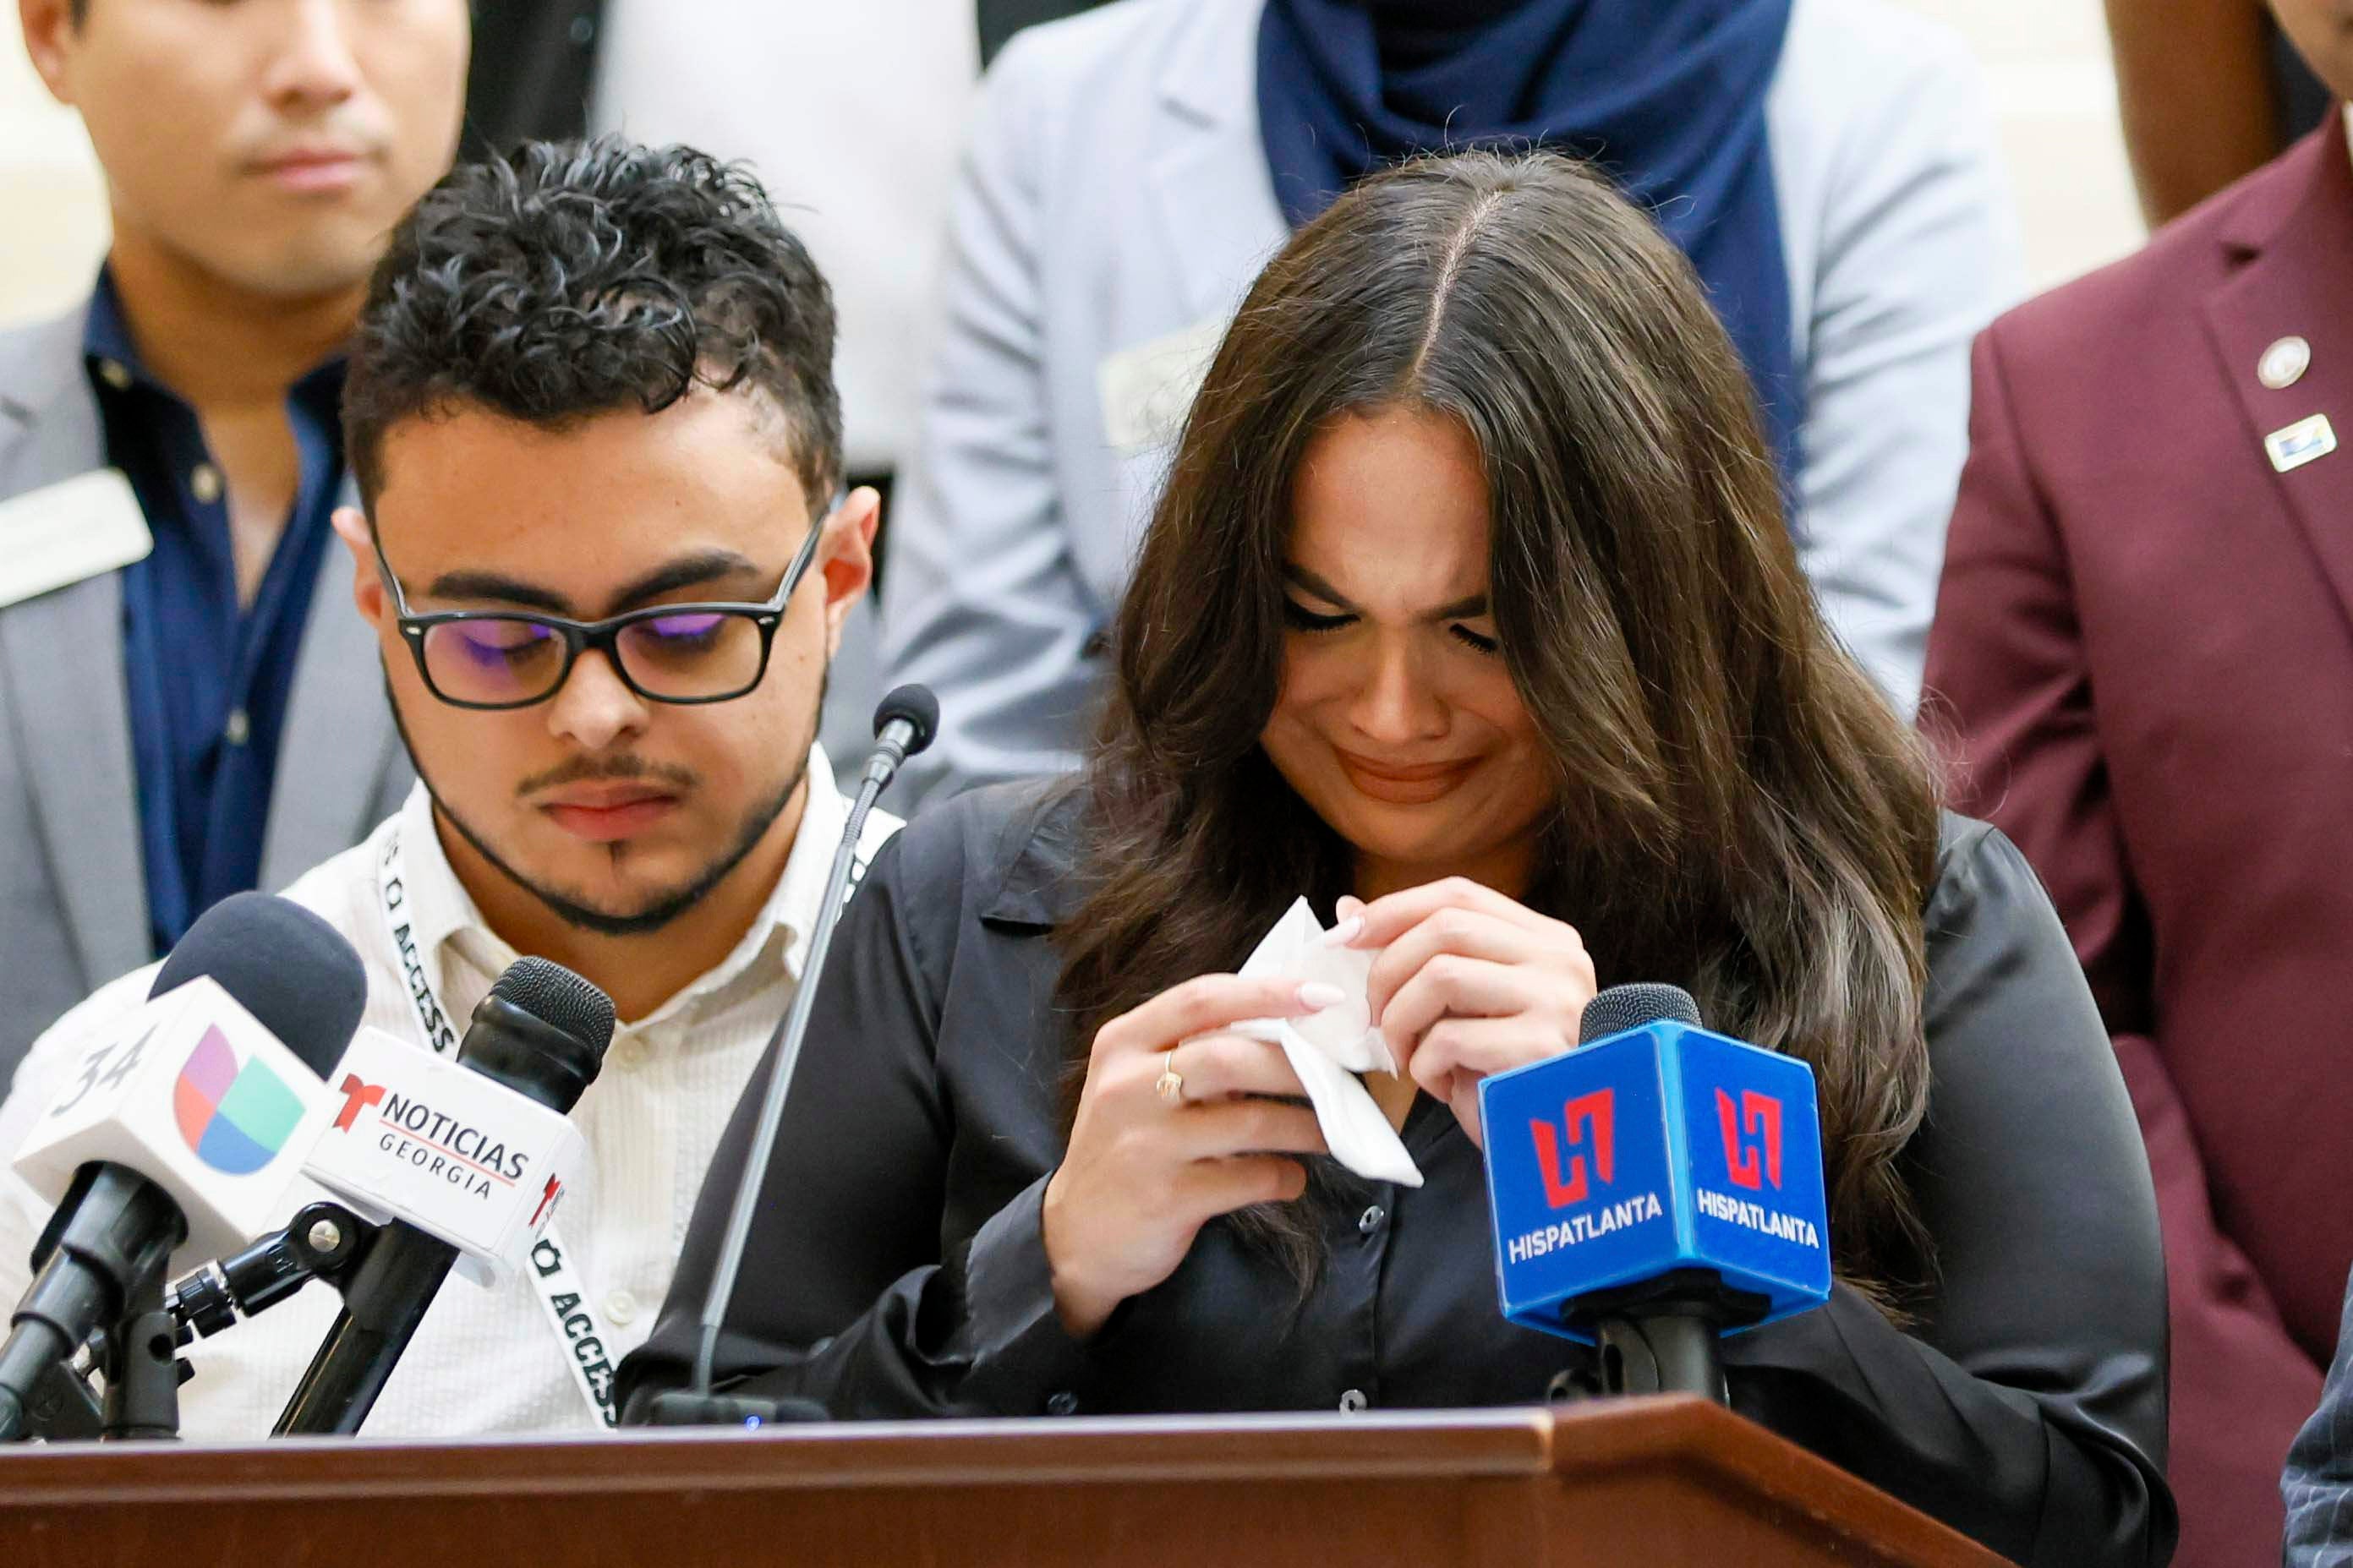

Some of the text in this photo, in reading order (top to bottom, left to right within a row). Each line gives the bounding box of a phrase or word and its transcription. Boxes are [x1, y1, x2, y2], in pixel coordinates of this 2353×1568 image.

[394, 923, 454, 1052] ACCESS
[50, 1022, 159, 1118] 34
[379, 1133, 492, 1199] GEORGIA
[382, 1093, 530, 1180] NOTICIAS
[1508, 1191, 1663, 1265] HISPATLANTA
[1696, 1188, 1820, 1249] HISPATLANTA
